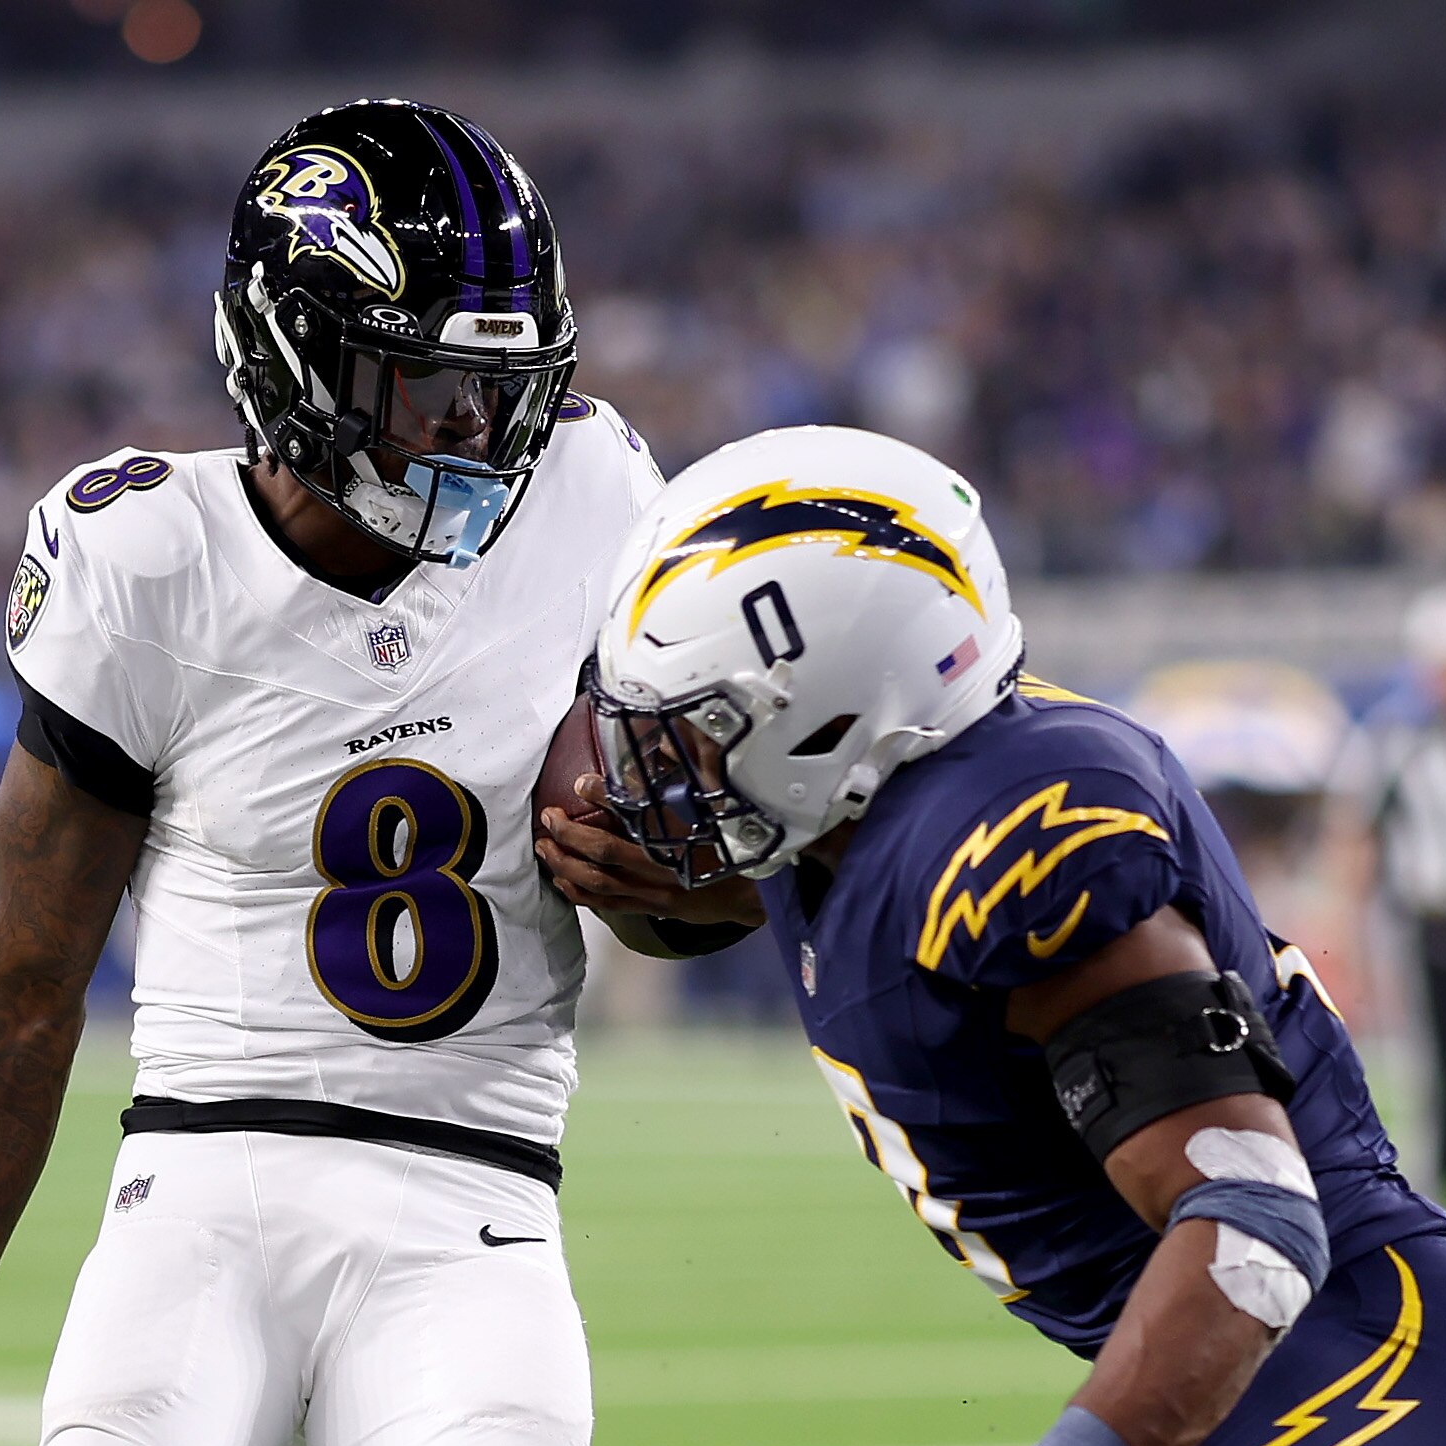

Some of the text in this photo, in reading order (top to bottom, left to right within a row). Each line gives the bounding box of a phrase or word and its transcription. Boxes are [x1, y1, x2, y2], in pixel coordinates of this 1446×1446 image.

[362, 317, 418, 335] OAKLEY
[474, 318, 524, 337] RAVENS
[66, 456, 174, 514] 8
[741, 580, 805, 669] 0
[375, 640, 406, 663] NFL
[343, 716, 453, 755] RAVENS
[306, 758, 500, 1043] 8
